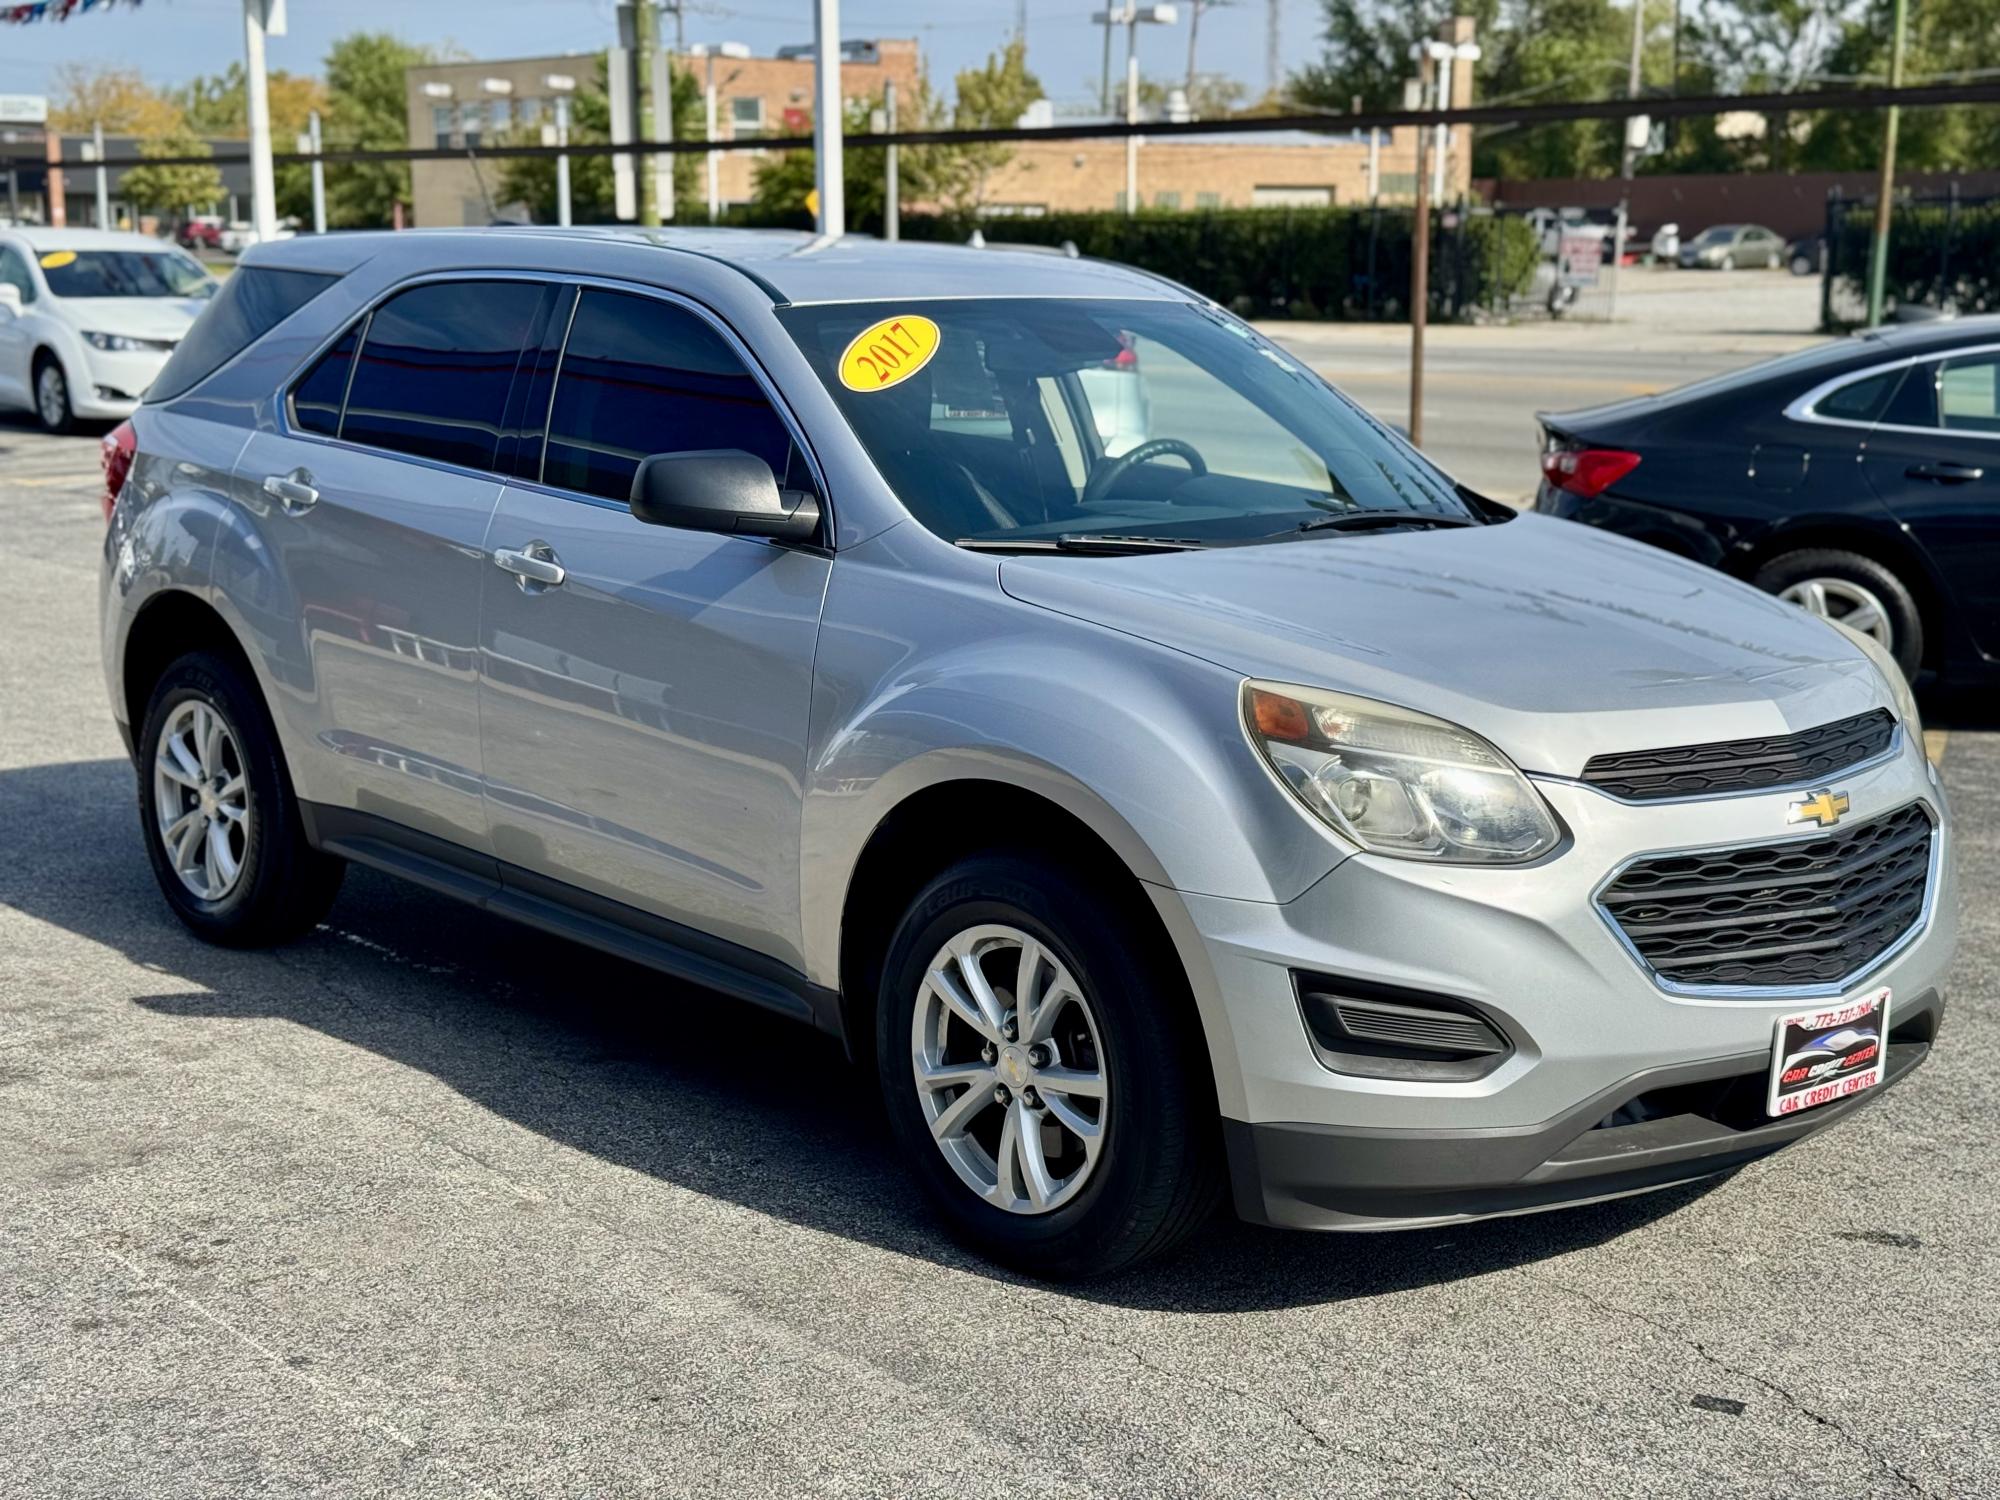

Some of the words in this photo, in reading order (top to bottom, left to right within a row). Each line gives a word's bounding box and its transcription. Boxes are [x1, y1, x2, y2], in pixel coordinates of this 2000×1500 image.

[856, 322, 920, 383] 2017
[1779, 1096, 1799, 1113] CAR
[1804, 1083, 1840, 1107] CREDIT
[1842, 1072, 1876, 1094] CENTER
[1782, 1068, 1809, 1083] CAR
